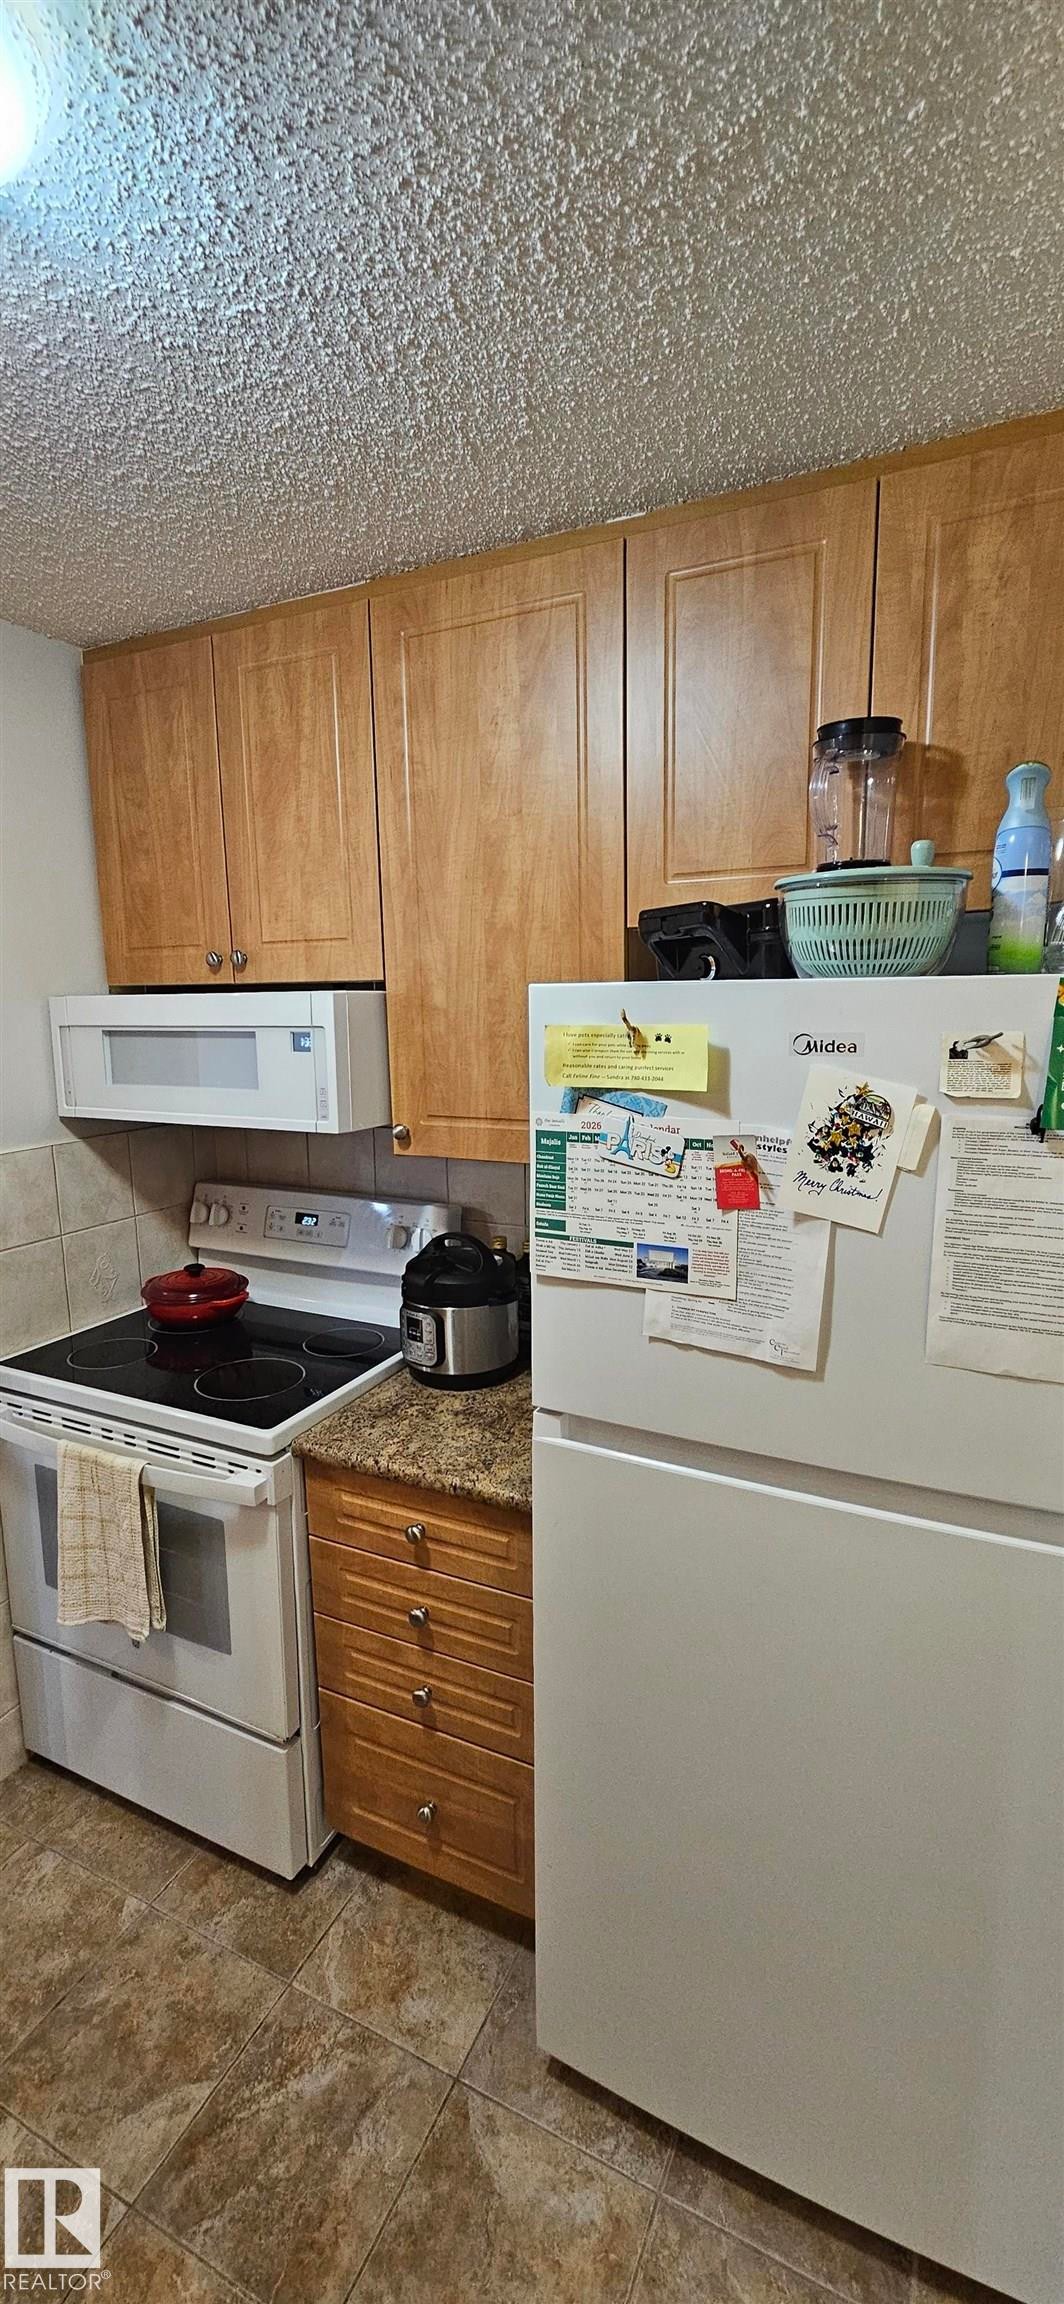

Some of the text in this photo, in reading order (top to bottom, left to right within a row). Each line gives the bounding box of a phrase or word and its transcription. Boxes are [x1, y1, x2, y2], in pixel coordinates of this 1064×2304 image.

[795, 1035, 857, 1055] Midea
[580, 1121, 602, 1130] 2026
[851, 1110, 888, 1128] HAWAII
[607, 1120, 667, 1164] PARIS
[756, 1136, 792, 1146] nhelpf
[756, 1144, 788, 1154] styles
[793, 1170, 827, 1196] Merry
[569, 1236, 597, 1244] FESTIVALS
